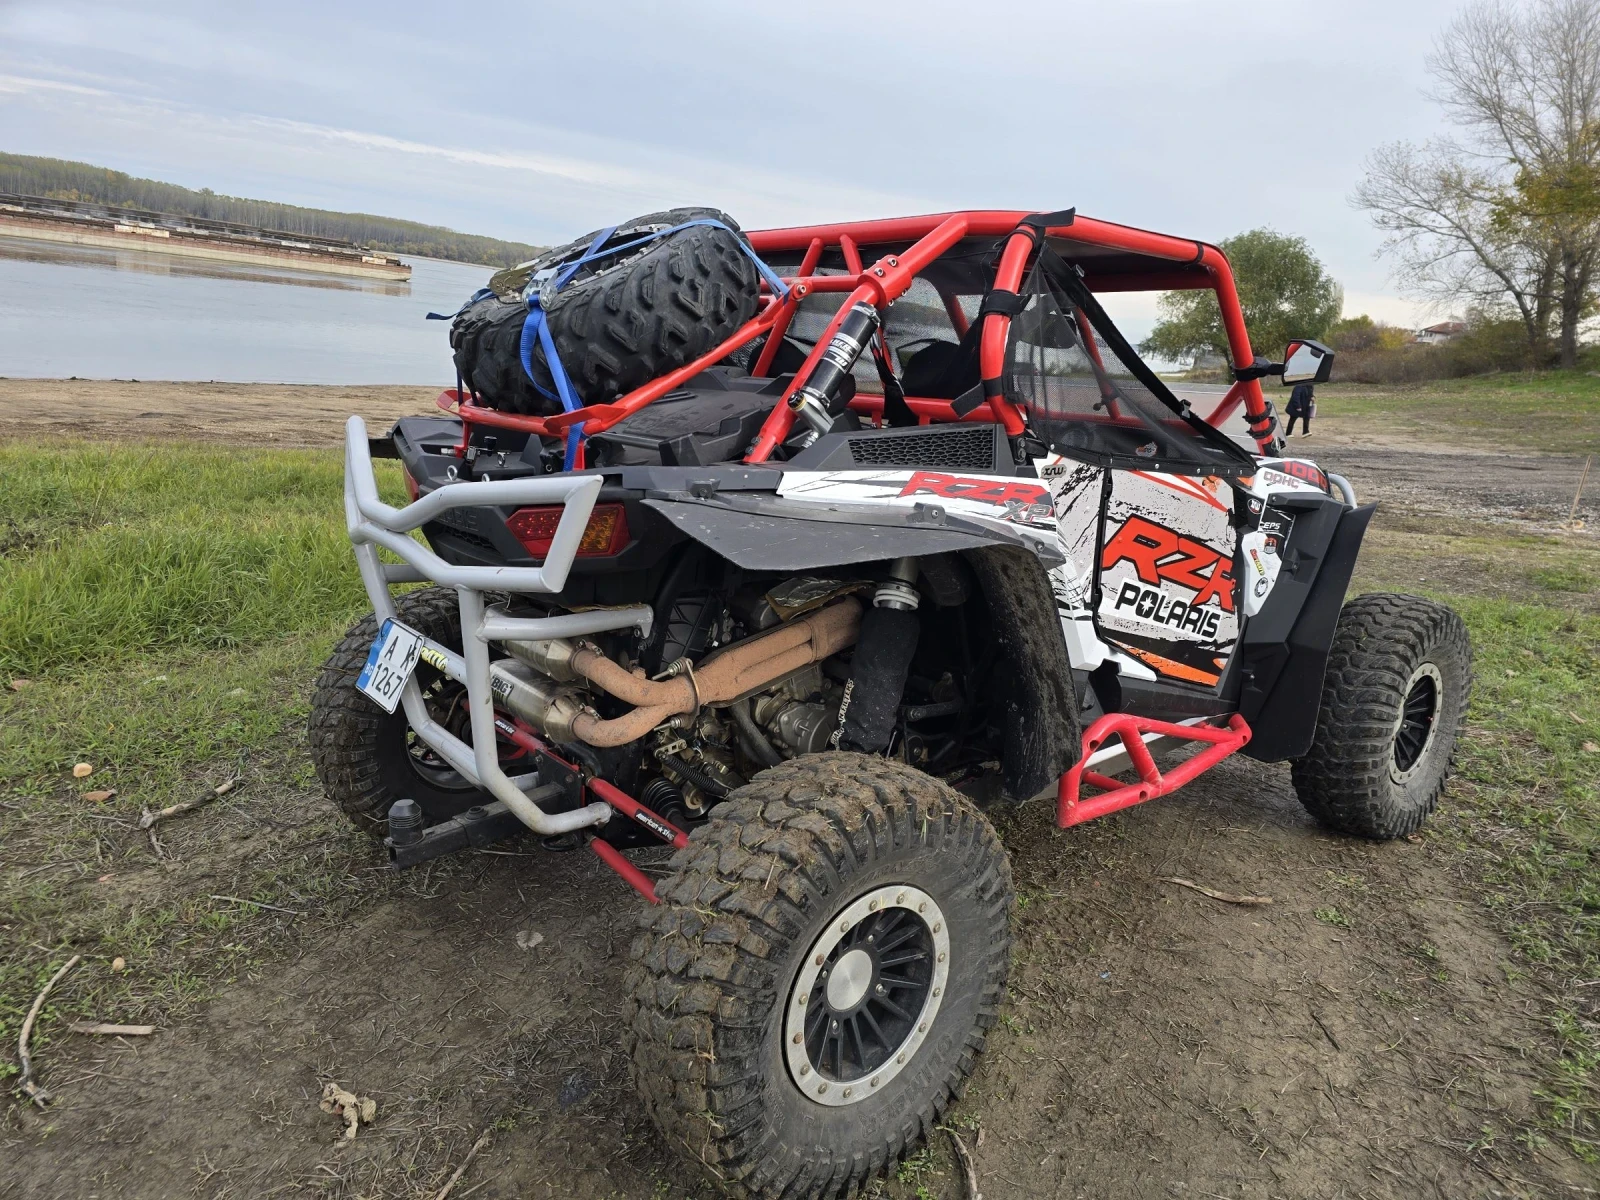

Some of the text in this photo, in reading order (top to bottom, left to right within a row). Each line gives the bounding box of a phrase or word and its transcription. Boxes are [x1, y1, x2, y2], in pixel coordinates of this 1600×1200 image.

[897, 471, 1051, 507] RZR
[998, 500, 1053, 523] XP
[1263, 521, 1281, 530] EPS
[1101, 515, 1236, 615] RZR
[1114, 582, 1221, 640] POLARIS
[384, 635, 399, 661] A
[371, 662, 404, 700] 1267
[491, 677, 509, 694] BIG
